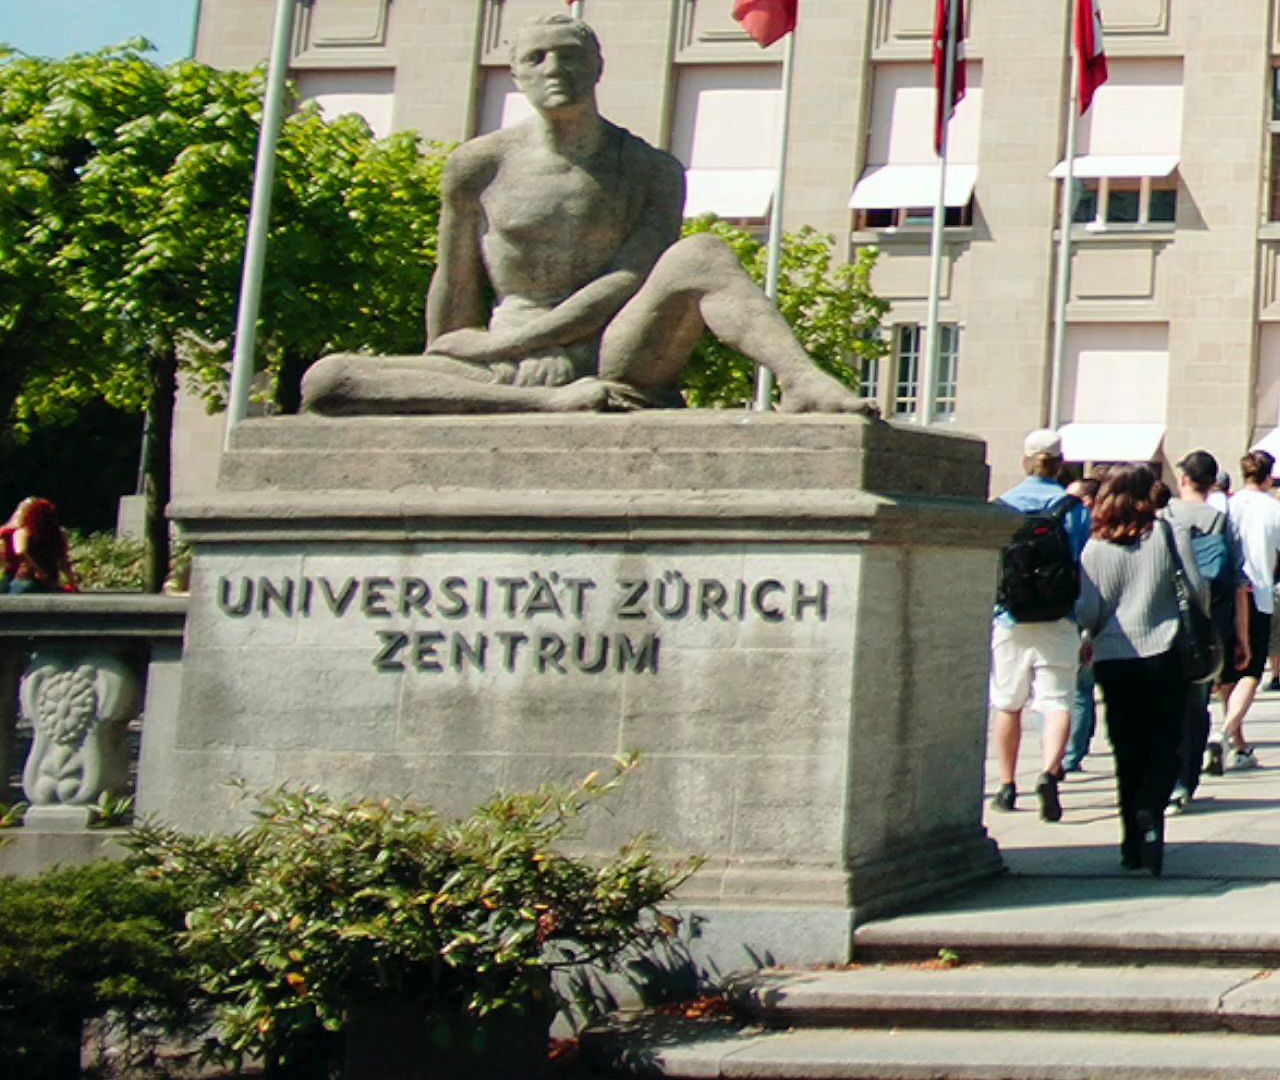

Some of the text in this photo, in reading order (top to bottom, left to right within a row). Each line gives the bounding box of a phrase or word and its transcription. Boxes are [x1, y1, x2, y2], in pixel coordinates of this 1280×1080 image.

[217, 569, 830, 622] UNIVERSITÄT ZÜRICH
[371, 629, 662, 676] ZENTRUM
